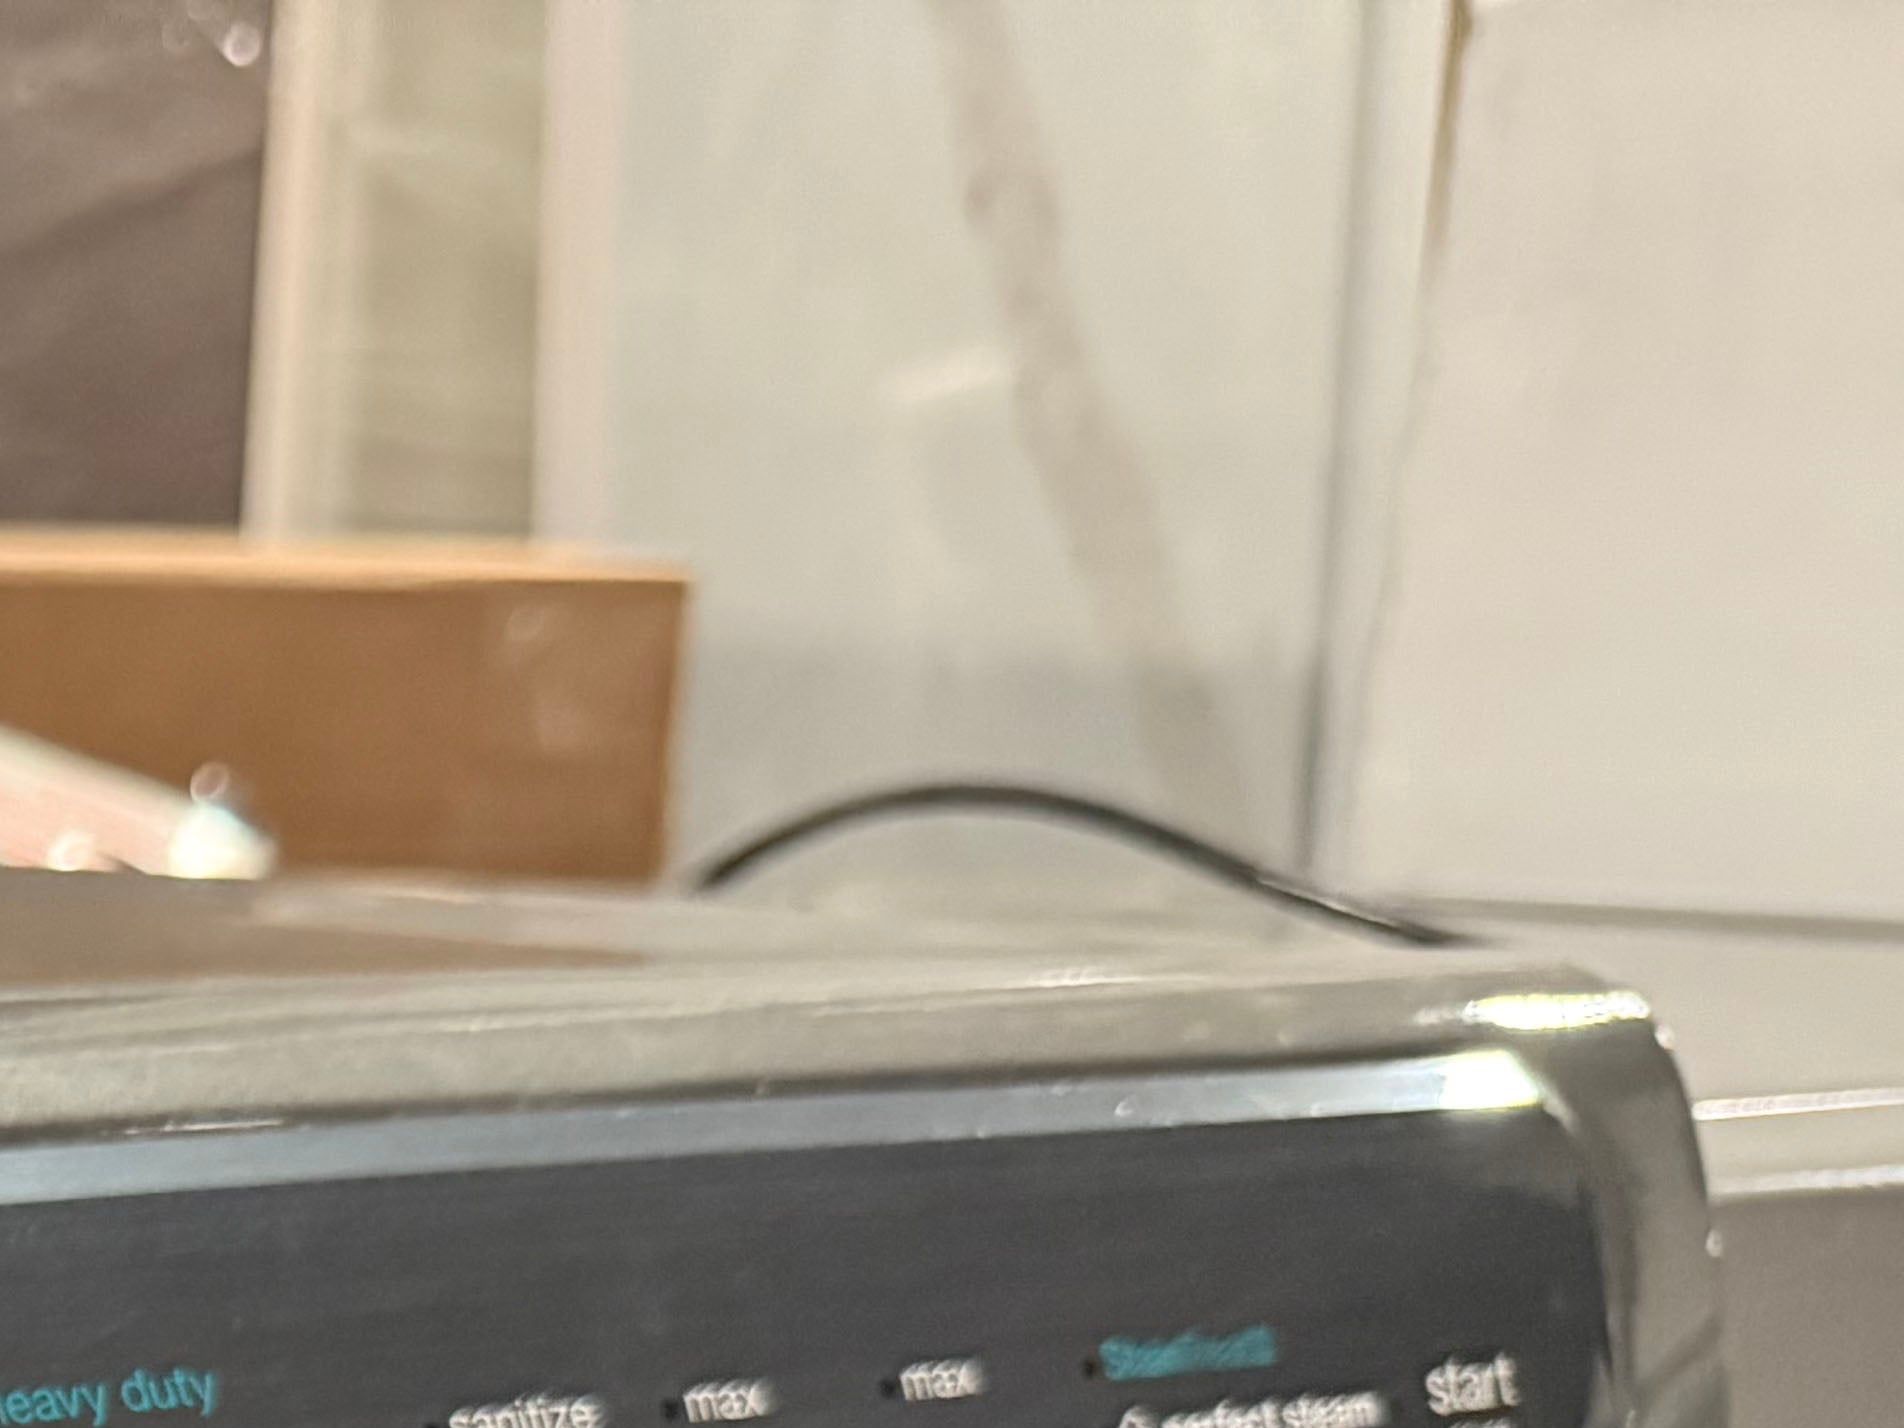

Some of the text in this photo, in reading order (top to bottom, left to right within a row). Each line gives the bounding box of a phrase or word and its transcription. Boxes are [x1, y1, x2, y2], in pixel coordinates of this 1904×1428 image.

[121, 1367, 218, 1417] duty
[683, 1378, 777, 1423] max
[900, 1357, 989, 1401] max
